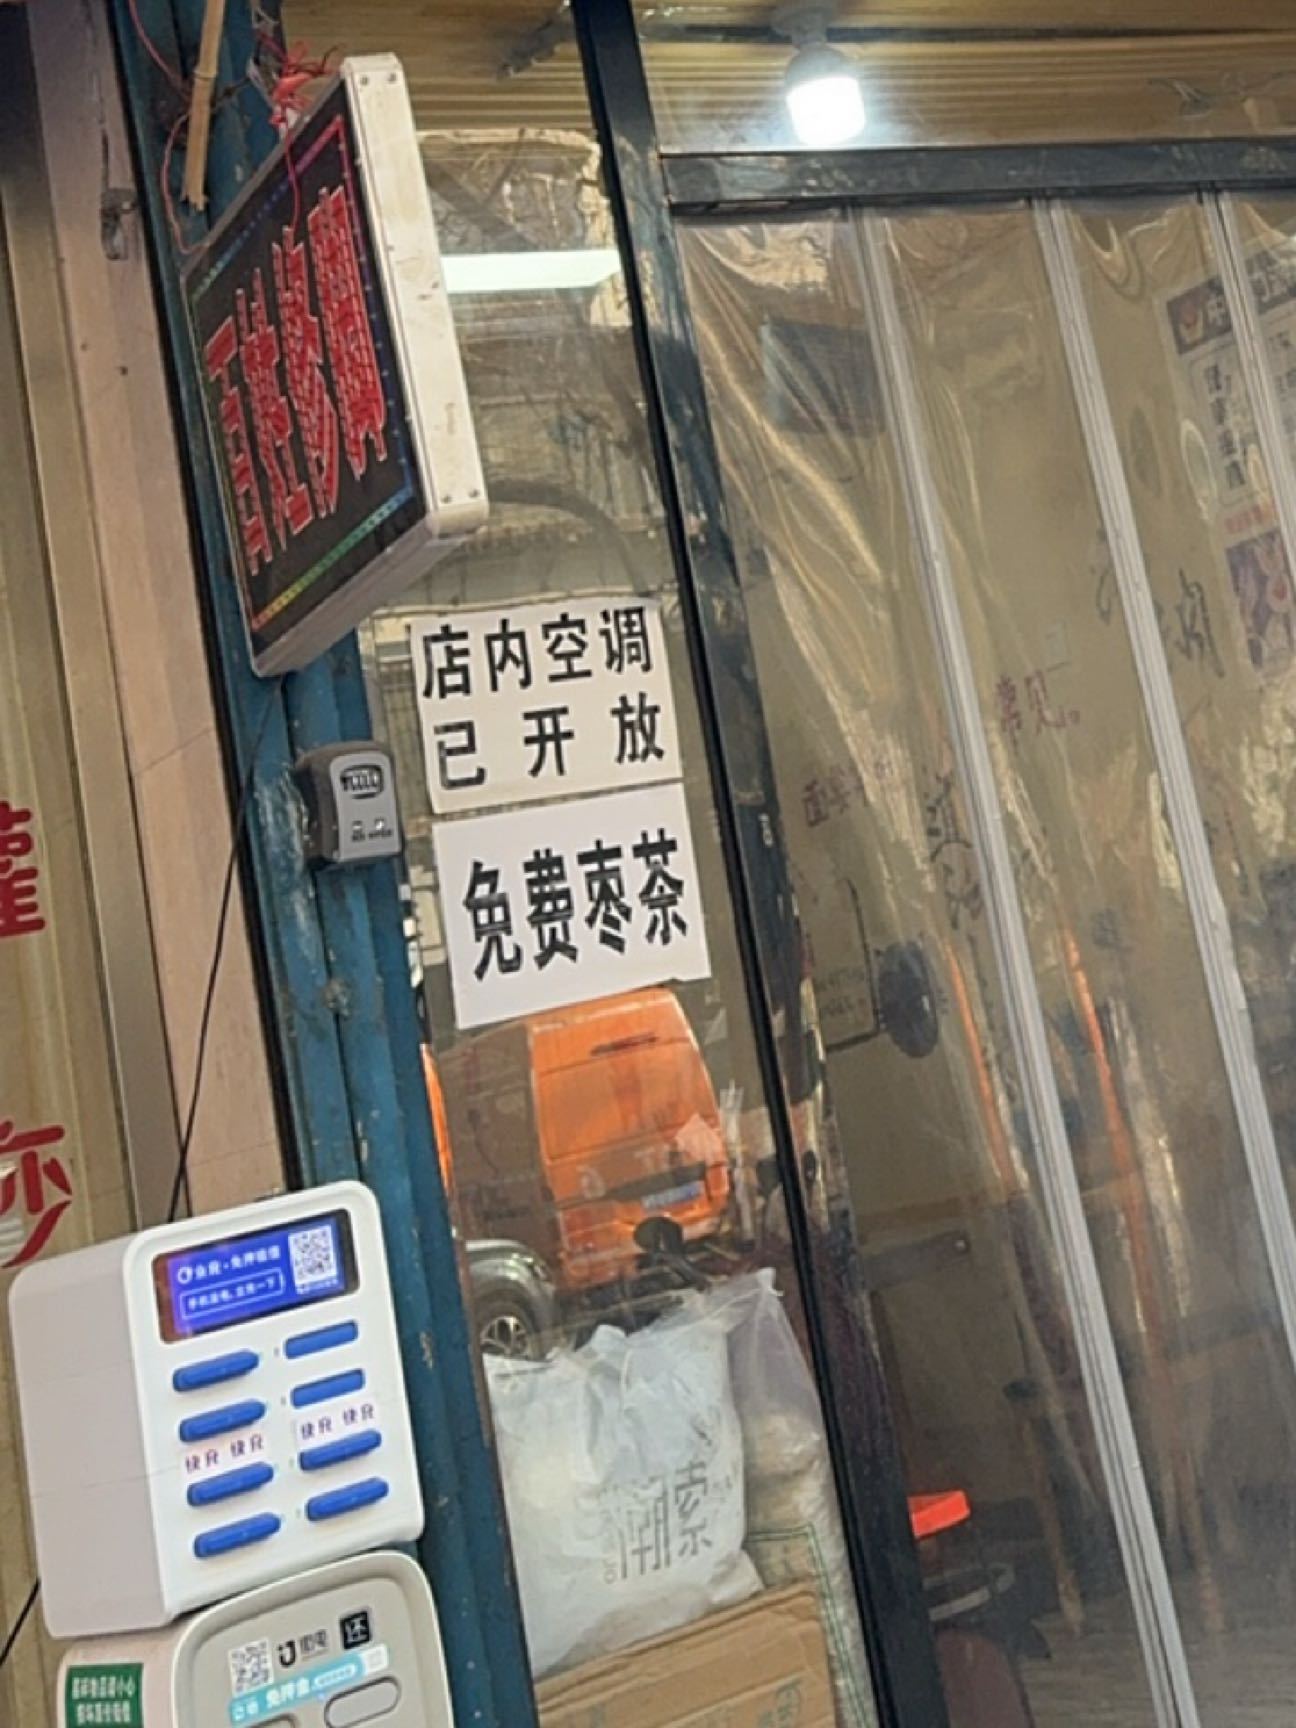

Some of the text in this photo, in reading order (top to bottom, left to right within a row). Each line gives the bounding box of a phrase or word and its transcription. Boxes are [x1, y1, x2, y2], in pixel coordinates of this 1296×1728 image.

[422, 605, 653, 700] 店内空调
[433, 691, 665, 791] 已开放
[463, 826, 689, 982] 免费枣茶
